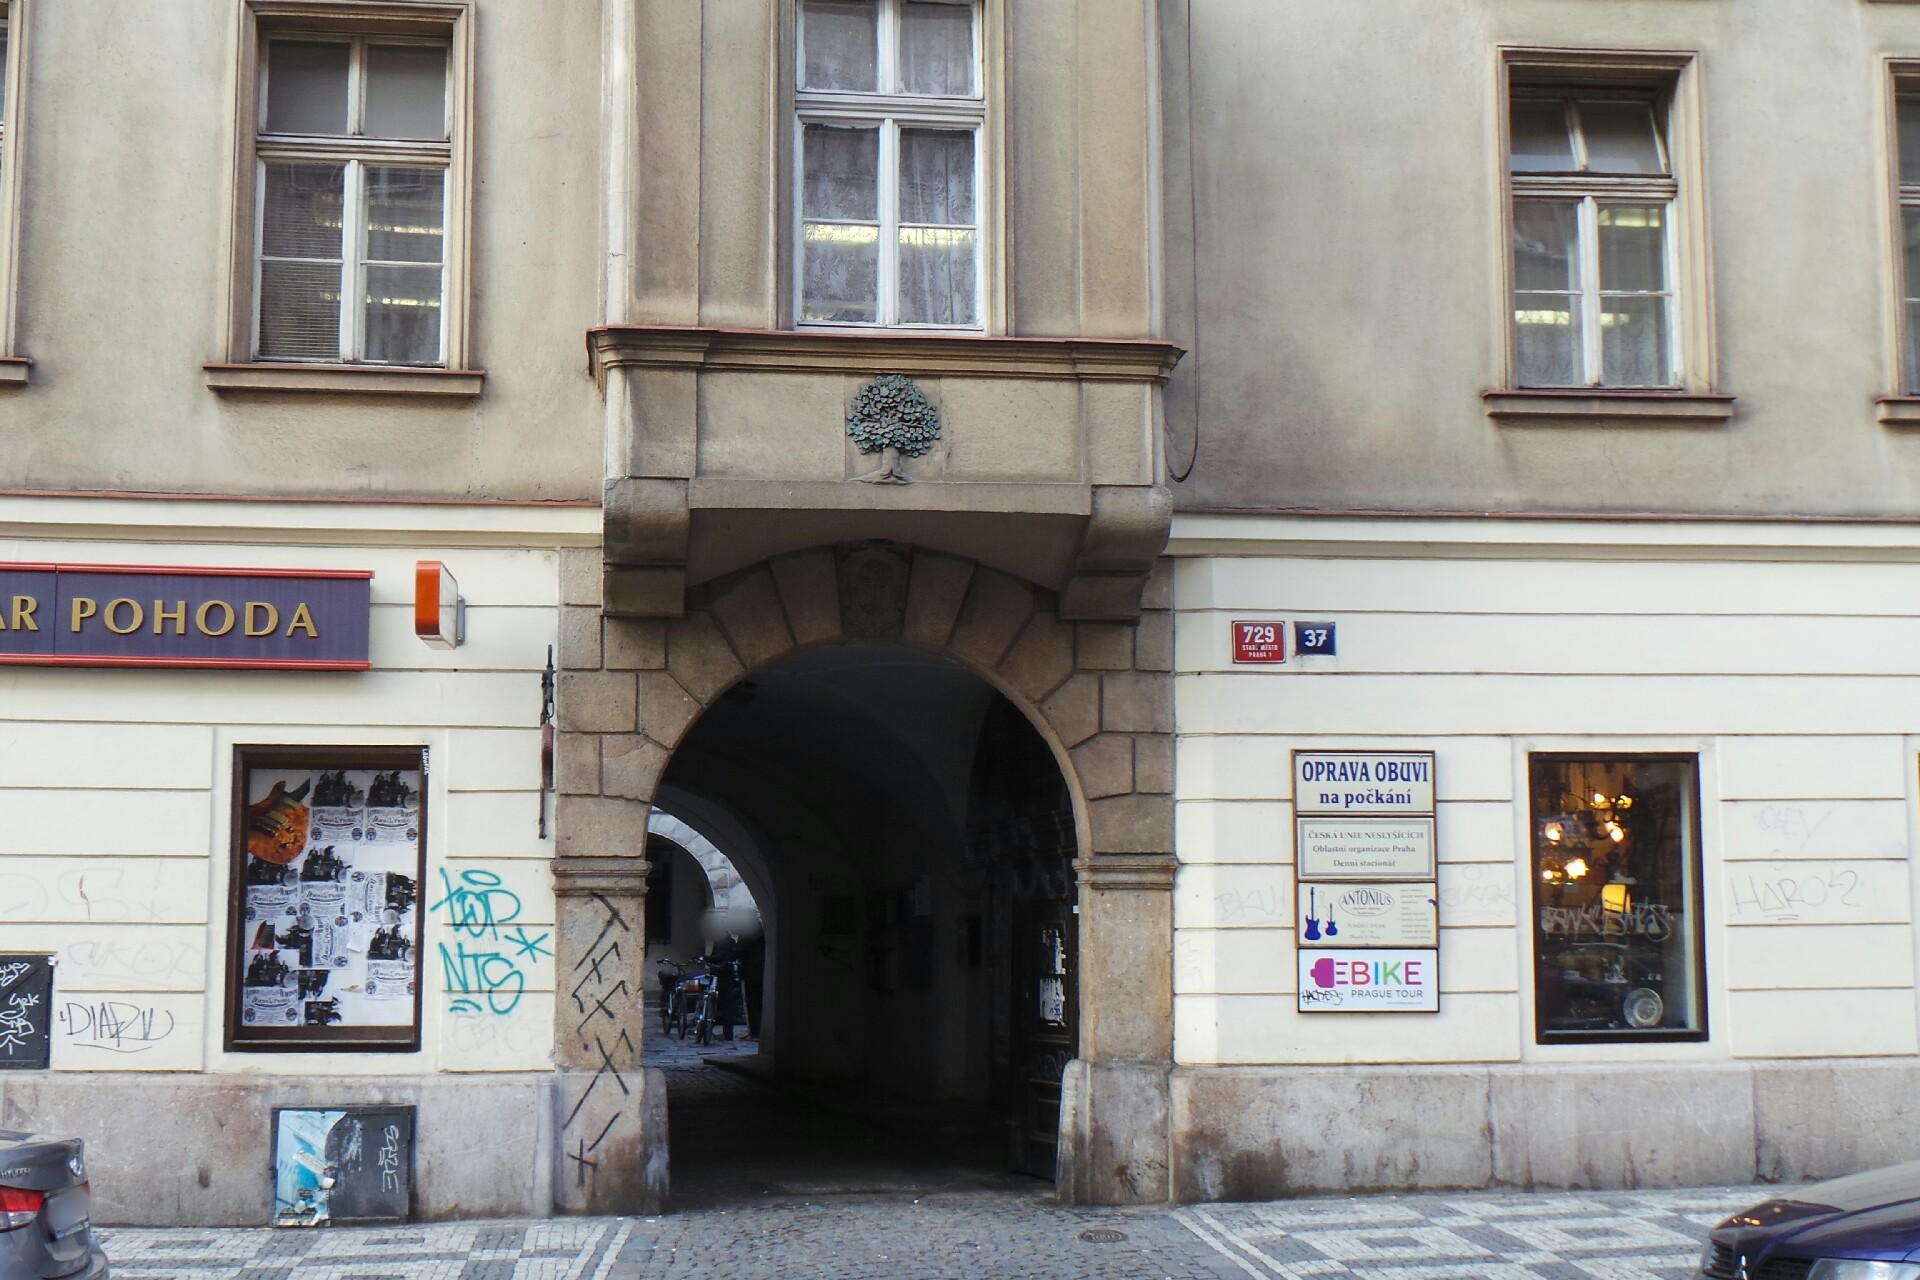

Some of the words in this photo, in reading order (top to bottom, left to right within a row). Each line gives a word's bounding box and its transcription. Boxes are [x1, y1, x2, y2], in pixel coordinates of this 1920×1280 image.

[0, 595, 40, 631] R
[71, 597, 319, 638] POHODA
[1243, 626, 1275, 643] 729
[1304, 629, 1328, 647] 37
[1302, 761, 1370, 782] OPRAVA
[1375, 761, 1428, 782] OBUVI
[1320, 792, 1339, 804] na
[1344, 788, 1412, 808] počkání
[1393, 844, 1416, 852] Praha
[1342, 889, 1392, 906] ANTONIUS
[1336, 961, 1423, 985] EBIKE
[1351, 989, 1392, 998] PRAGUE
[1396, 989, 1424, 998] TOUR
